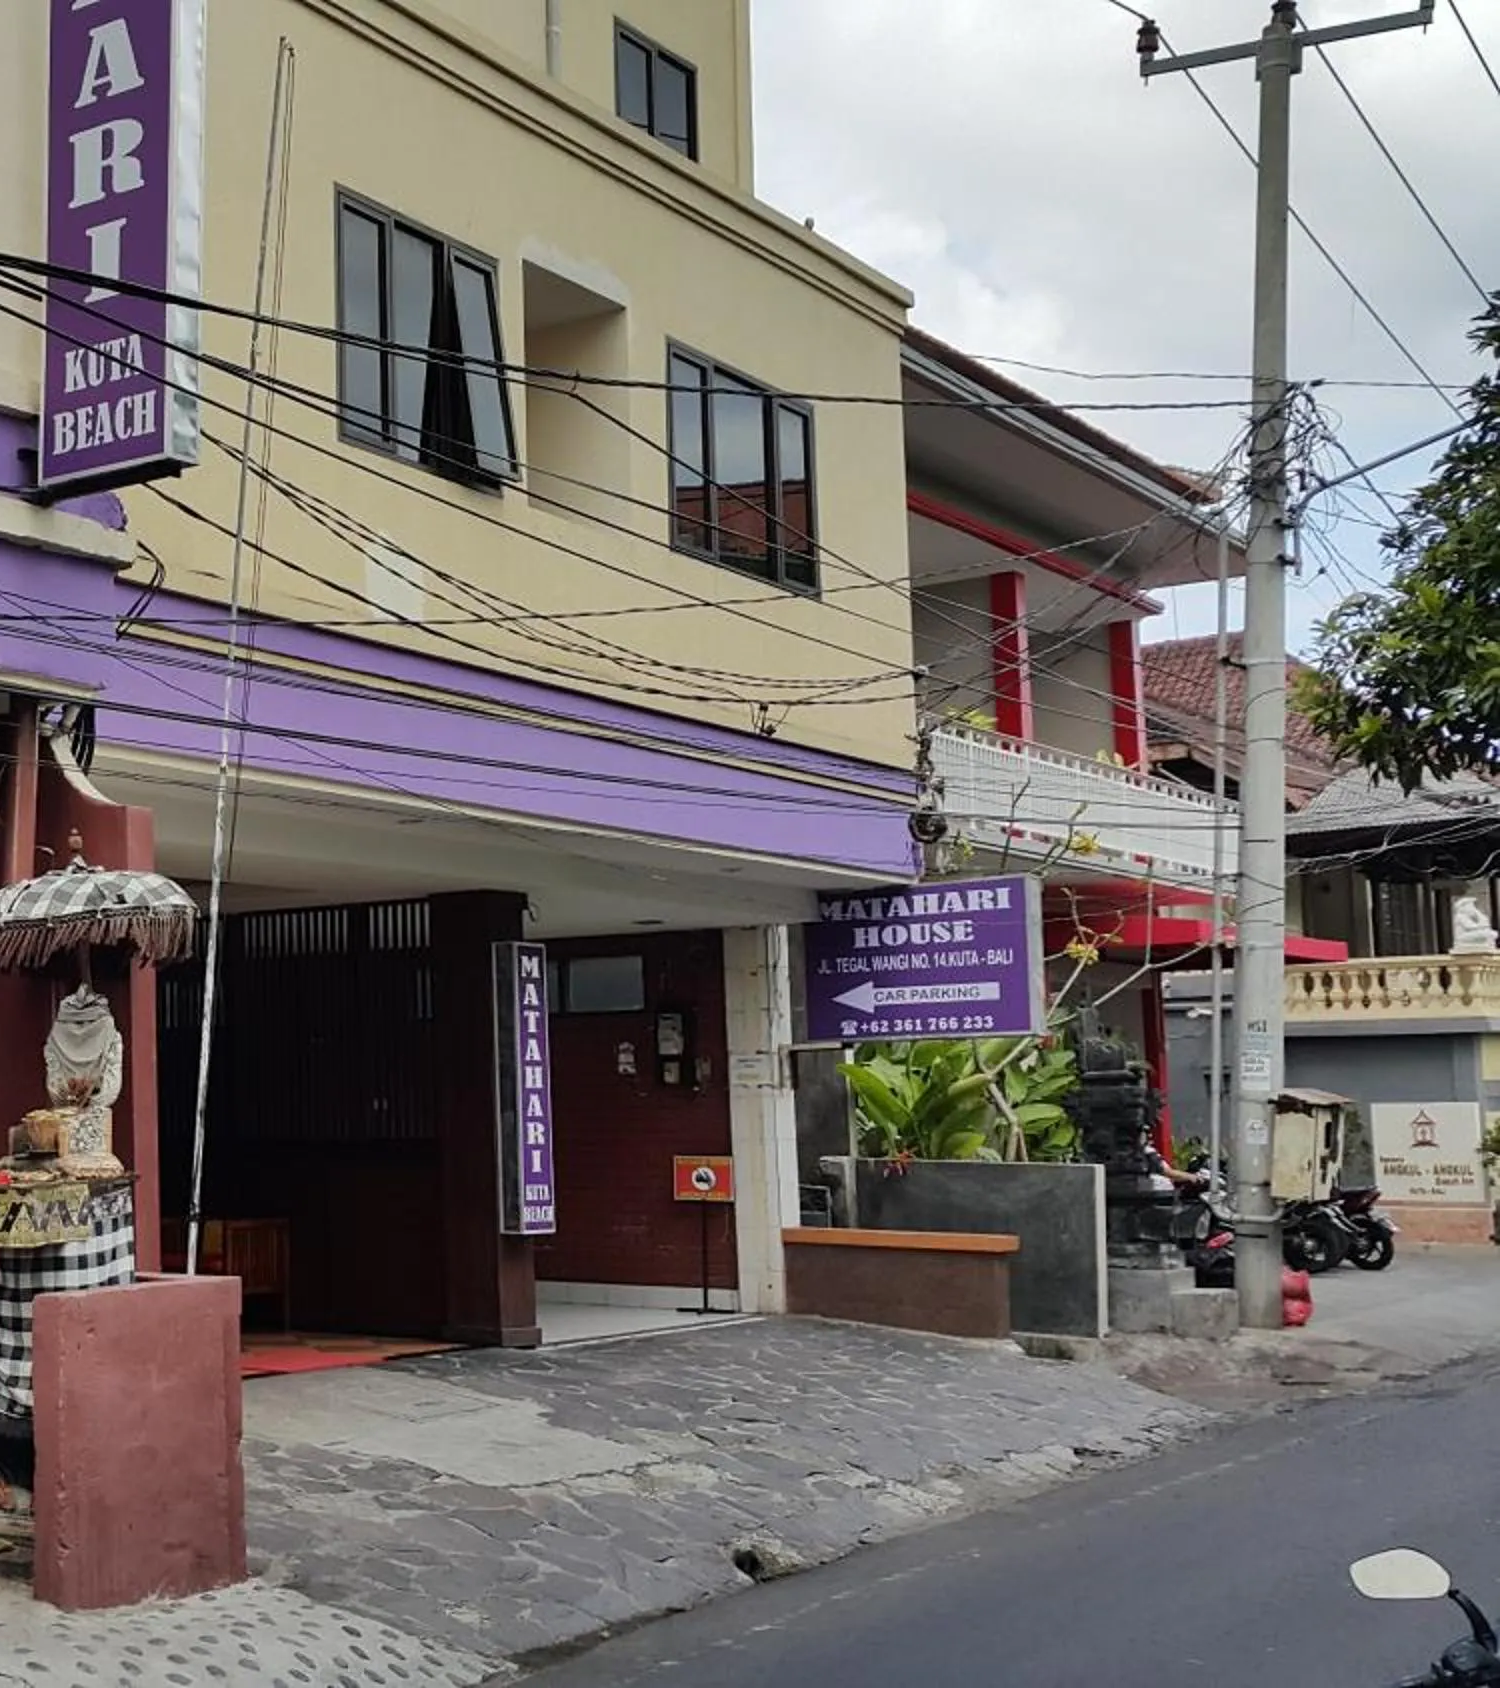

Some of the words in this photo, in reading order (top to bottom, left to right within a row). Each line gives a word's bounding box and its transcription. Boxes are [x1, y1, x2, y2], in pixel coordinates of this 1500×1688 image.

[68, 0, 145, 303] ARI
[64, 333, 145, 393] KUTA
[52, 389, 157, 456] BEACH
[820, 887, 1012, 921] MATAHARI
[853, 919, 975, 949] HOUSE
[836, 957, 872, 974] TEGAL
[871, 953, 909, 971] WANGI
[987, 948, 1014, 966] BALI
[874, 988, 907, 1003] CAR
[910, 985, 981, 1001] PARKING
[860, 1019, 890, 1034] +62
[893, 1018, 923, 1032] 361
[927, 1016, 959, 1031] 766
[963, 1015, 995, 1030] 233
[520, 955, 546, 1173] MATAHARI
